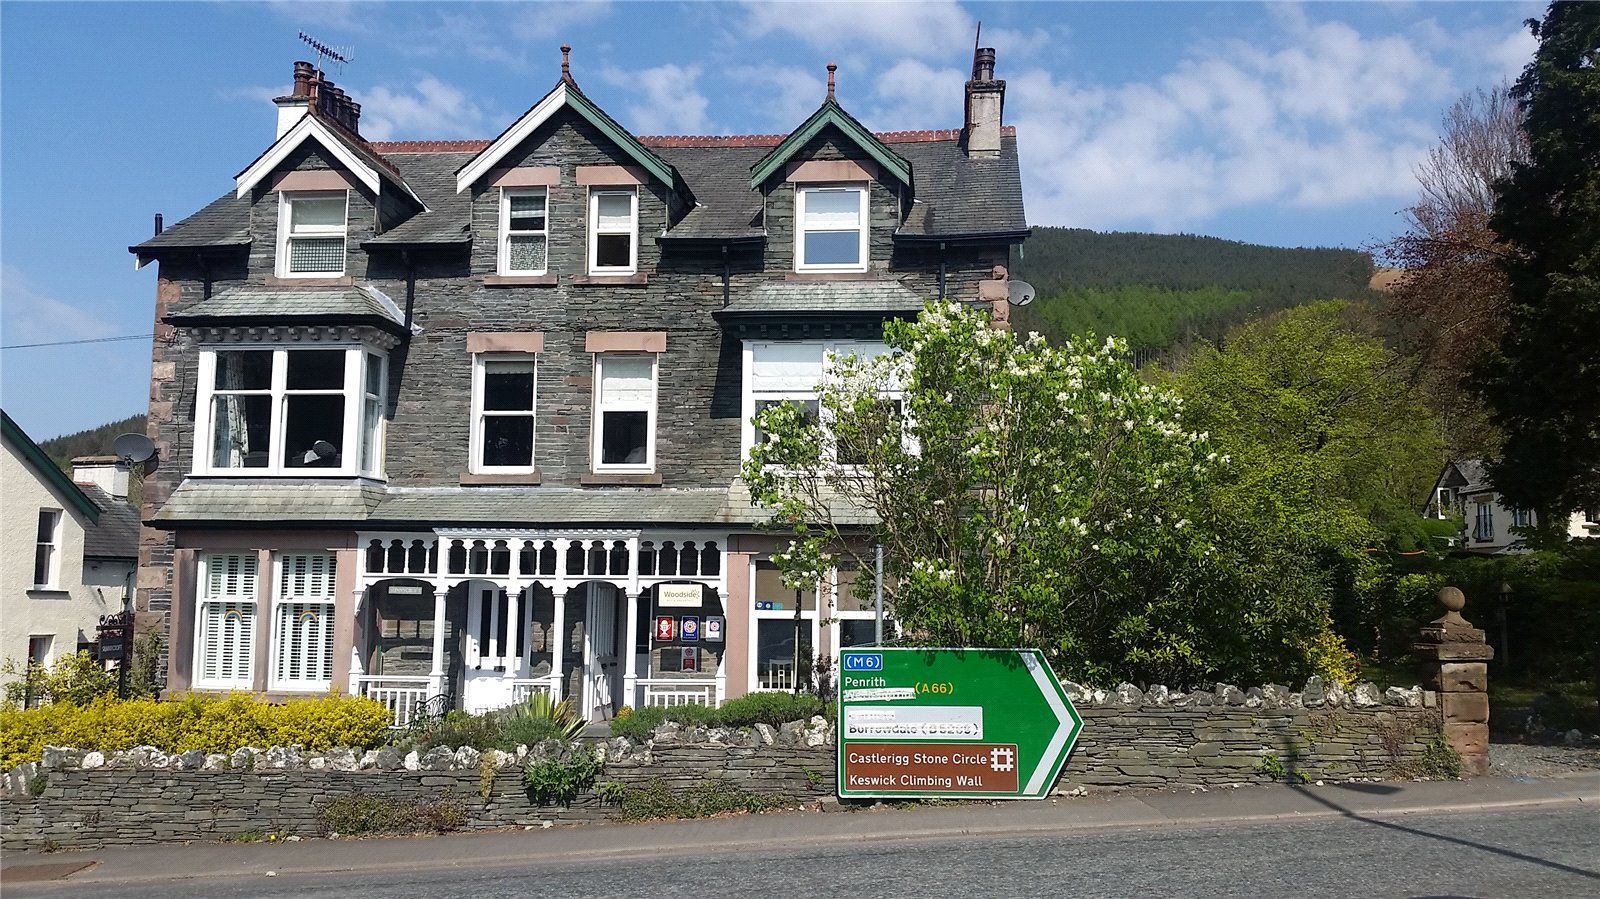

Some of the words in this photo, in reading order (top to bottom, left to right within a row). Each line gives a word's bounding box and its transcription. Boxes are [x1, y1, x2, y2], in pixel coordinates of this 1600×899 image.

[845, 677, 886, 687] Penrith
[915, 682, 954, 695] (A66)
[849, 753, 909, 765] Castlerigg
[913, 754, 949, 764] Stone
[952, 754, 988, 765] Circle
[849, 775, 897, 786] Keswick
[900, 775, 952, 787] Climbing
[956, 776, 983, 786] Wall
